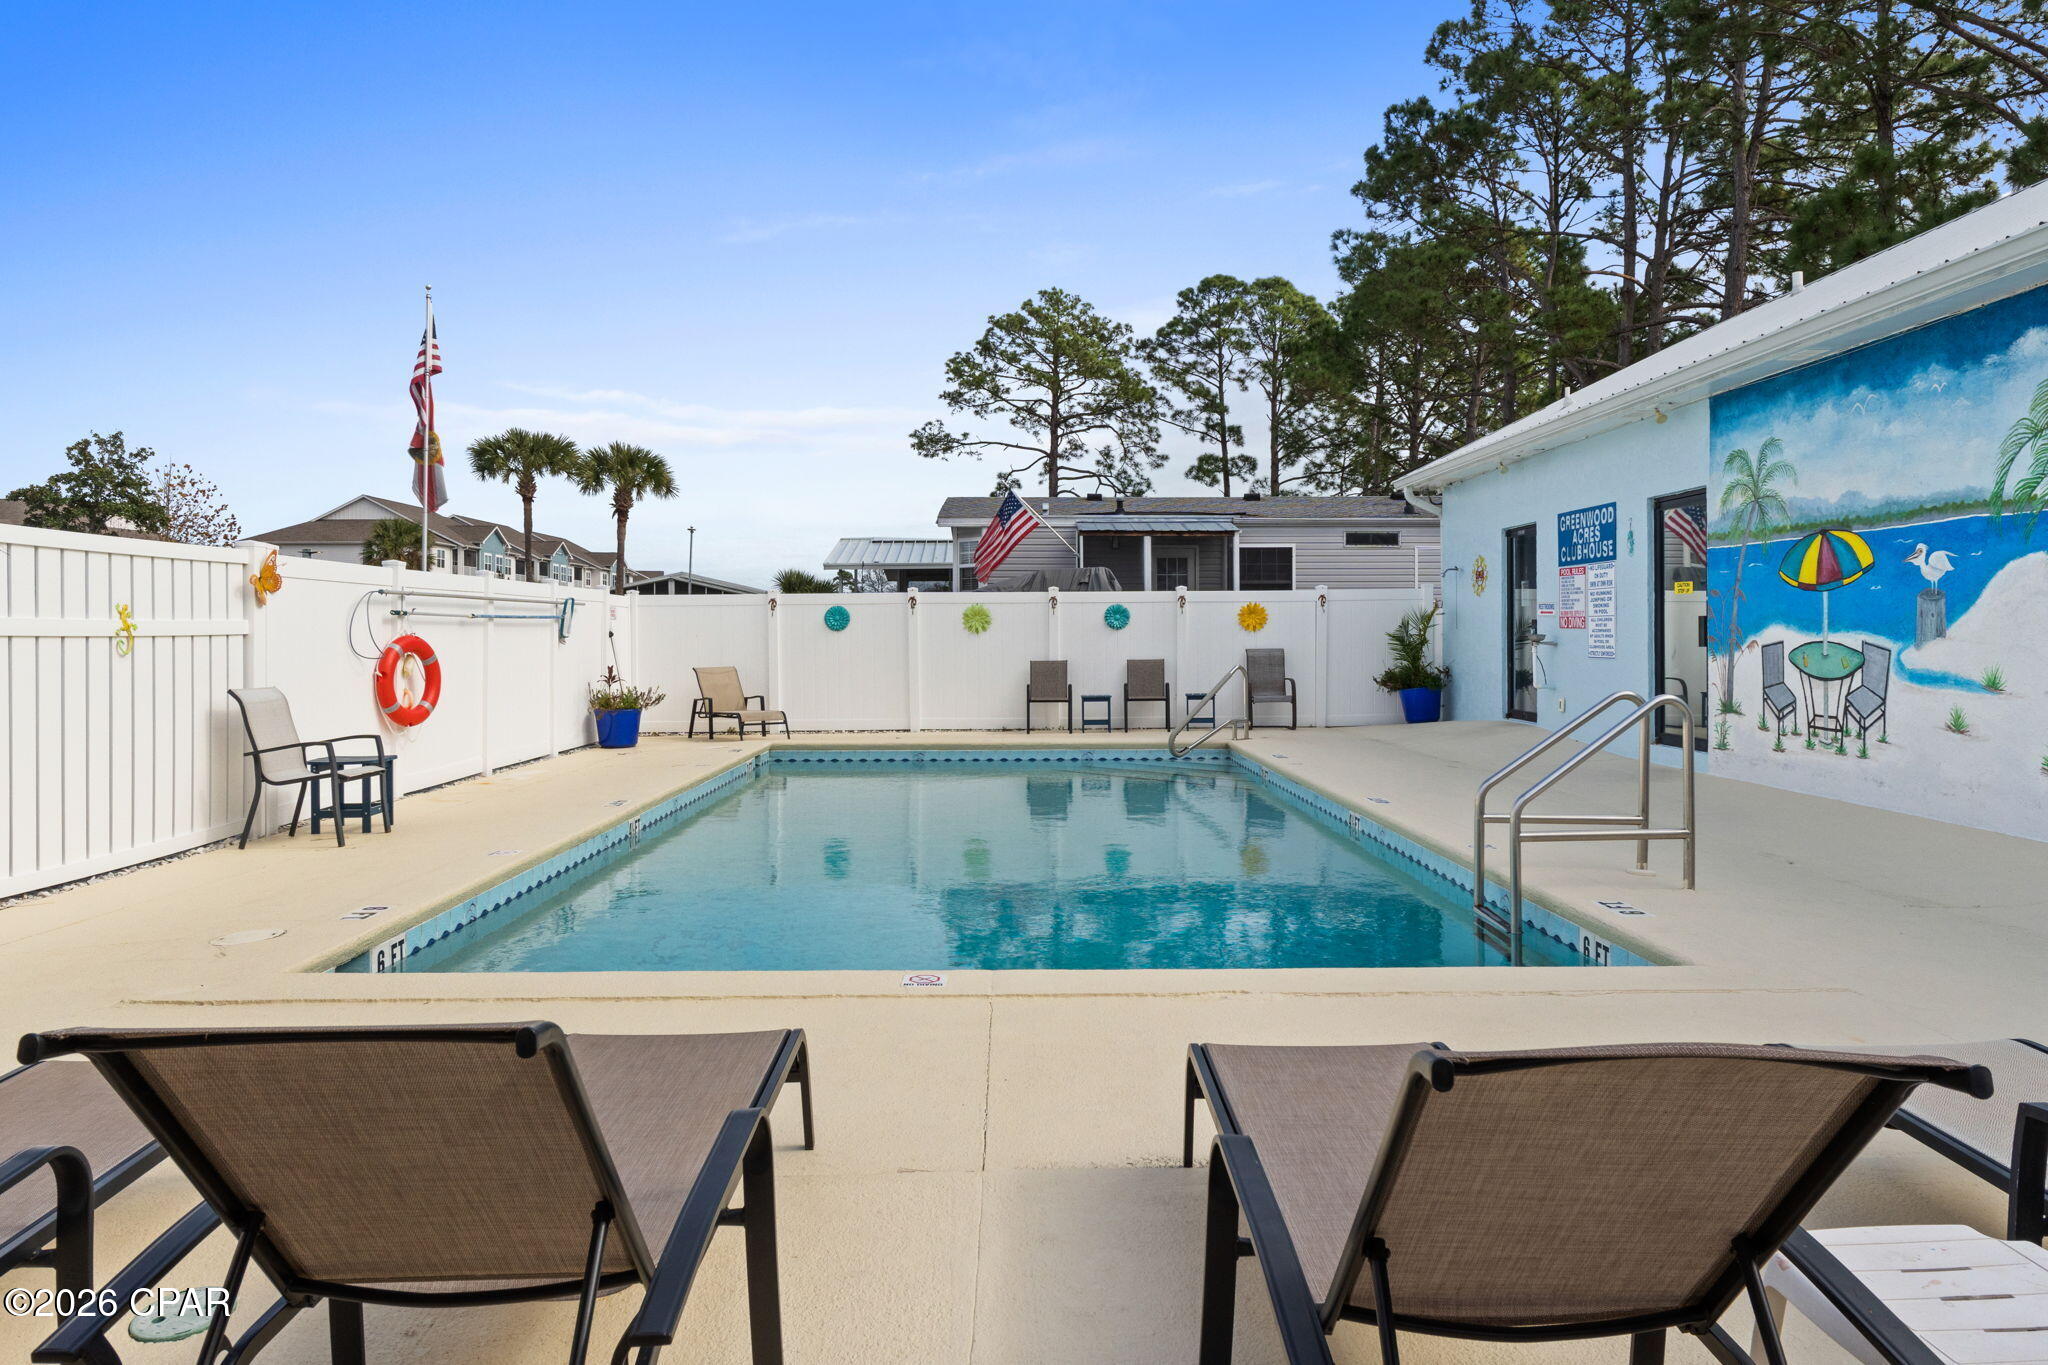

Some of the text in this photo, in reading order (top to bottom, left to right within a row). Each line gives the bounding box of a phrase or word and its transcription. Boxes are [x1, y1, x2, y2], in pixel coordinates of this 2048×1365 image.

[1560, 507, 1614, 532] GREENWOOD
[1572, 525, 1601, 544] ACRES
[1560, 540, 1614, 562] CLUBHOUSE
[1560, 567, 1584, 576] POOL RULES
[1560, 616, 1585, 628] NO DIVING
[377, 938, 405, 973] 6 FT
[1595, 940, 1610, 967] FT
